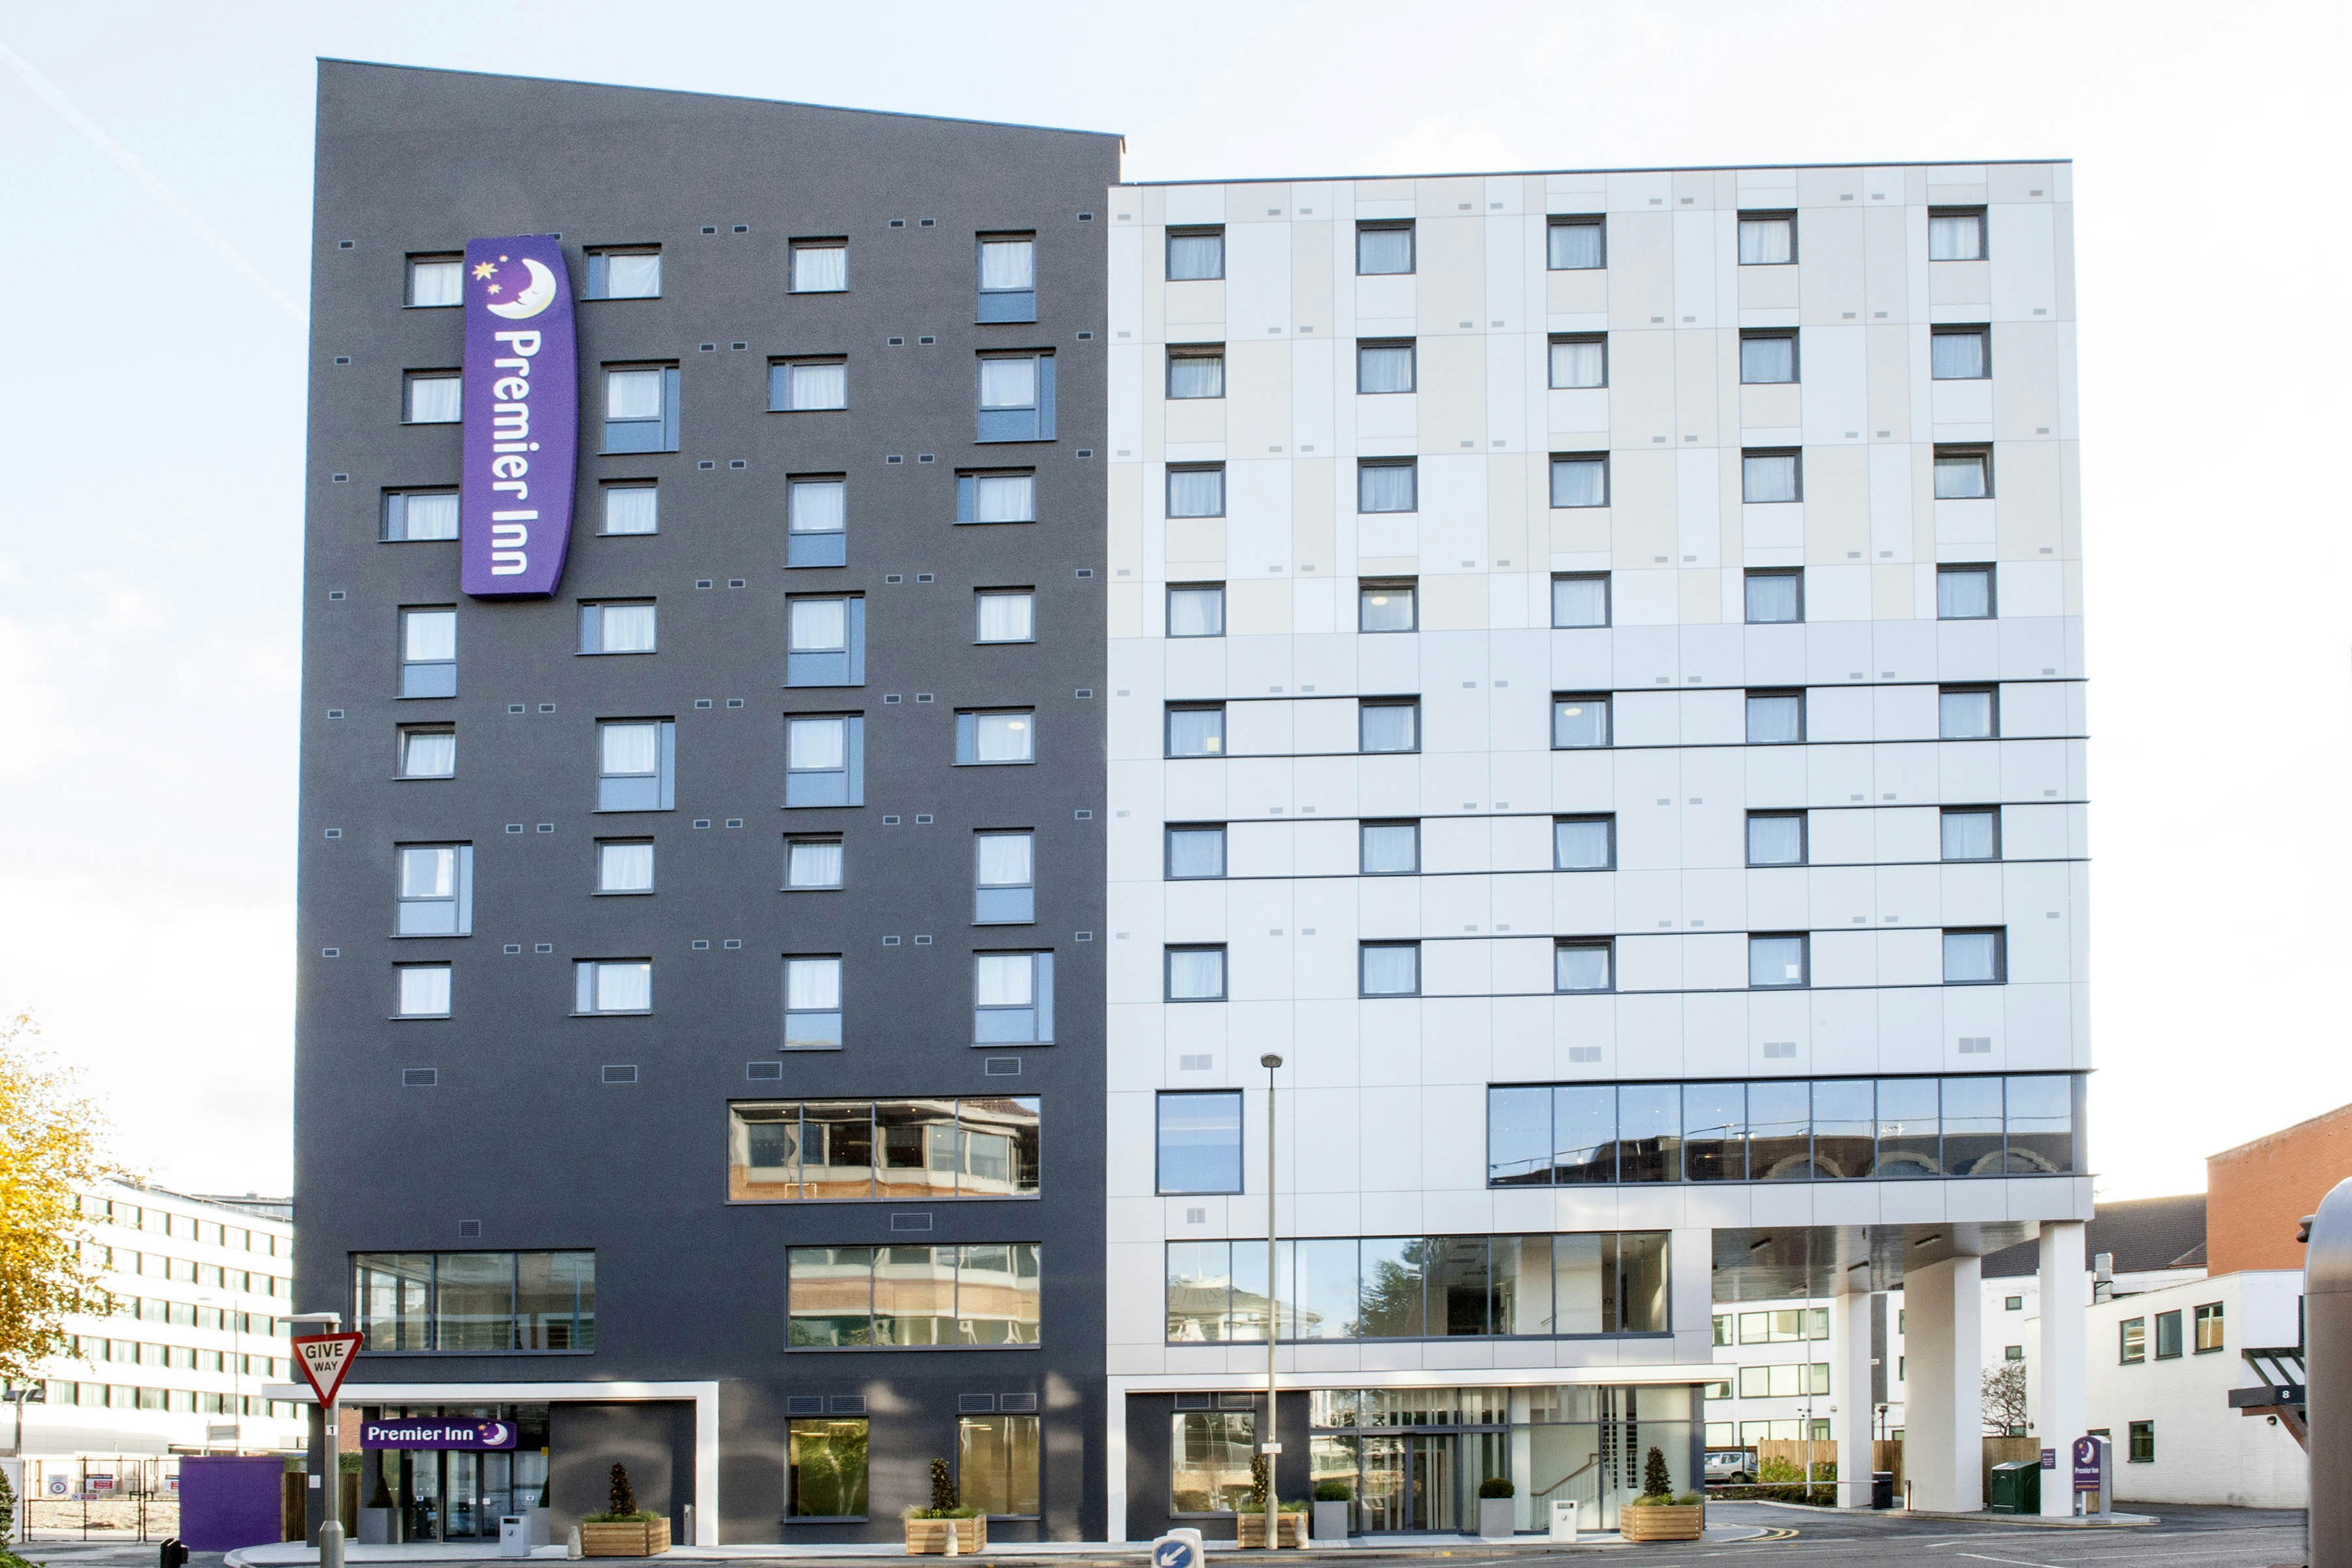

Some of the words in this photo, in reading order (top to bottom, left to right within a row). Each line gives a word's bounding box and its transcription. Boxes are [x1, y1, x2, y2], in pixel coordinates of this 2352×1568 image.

[492, 331, 541, 500] Premier
[491, 510, 538, 576] Inn
[305, 1343, 344, 1359] GIVE
[314, 1361, 338, 1372] WAY
[2281, 1390, 2290, 1399] 8
[368, 1426, 442, 1441] Premier
[445, 1426, 474, 1441] Inn
